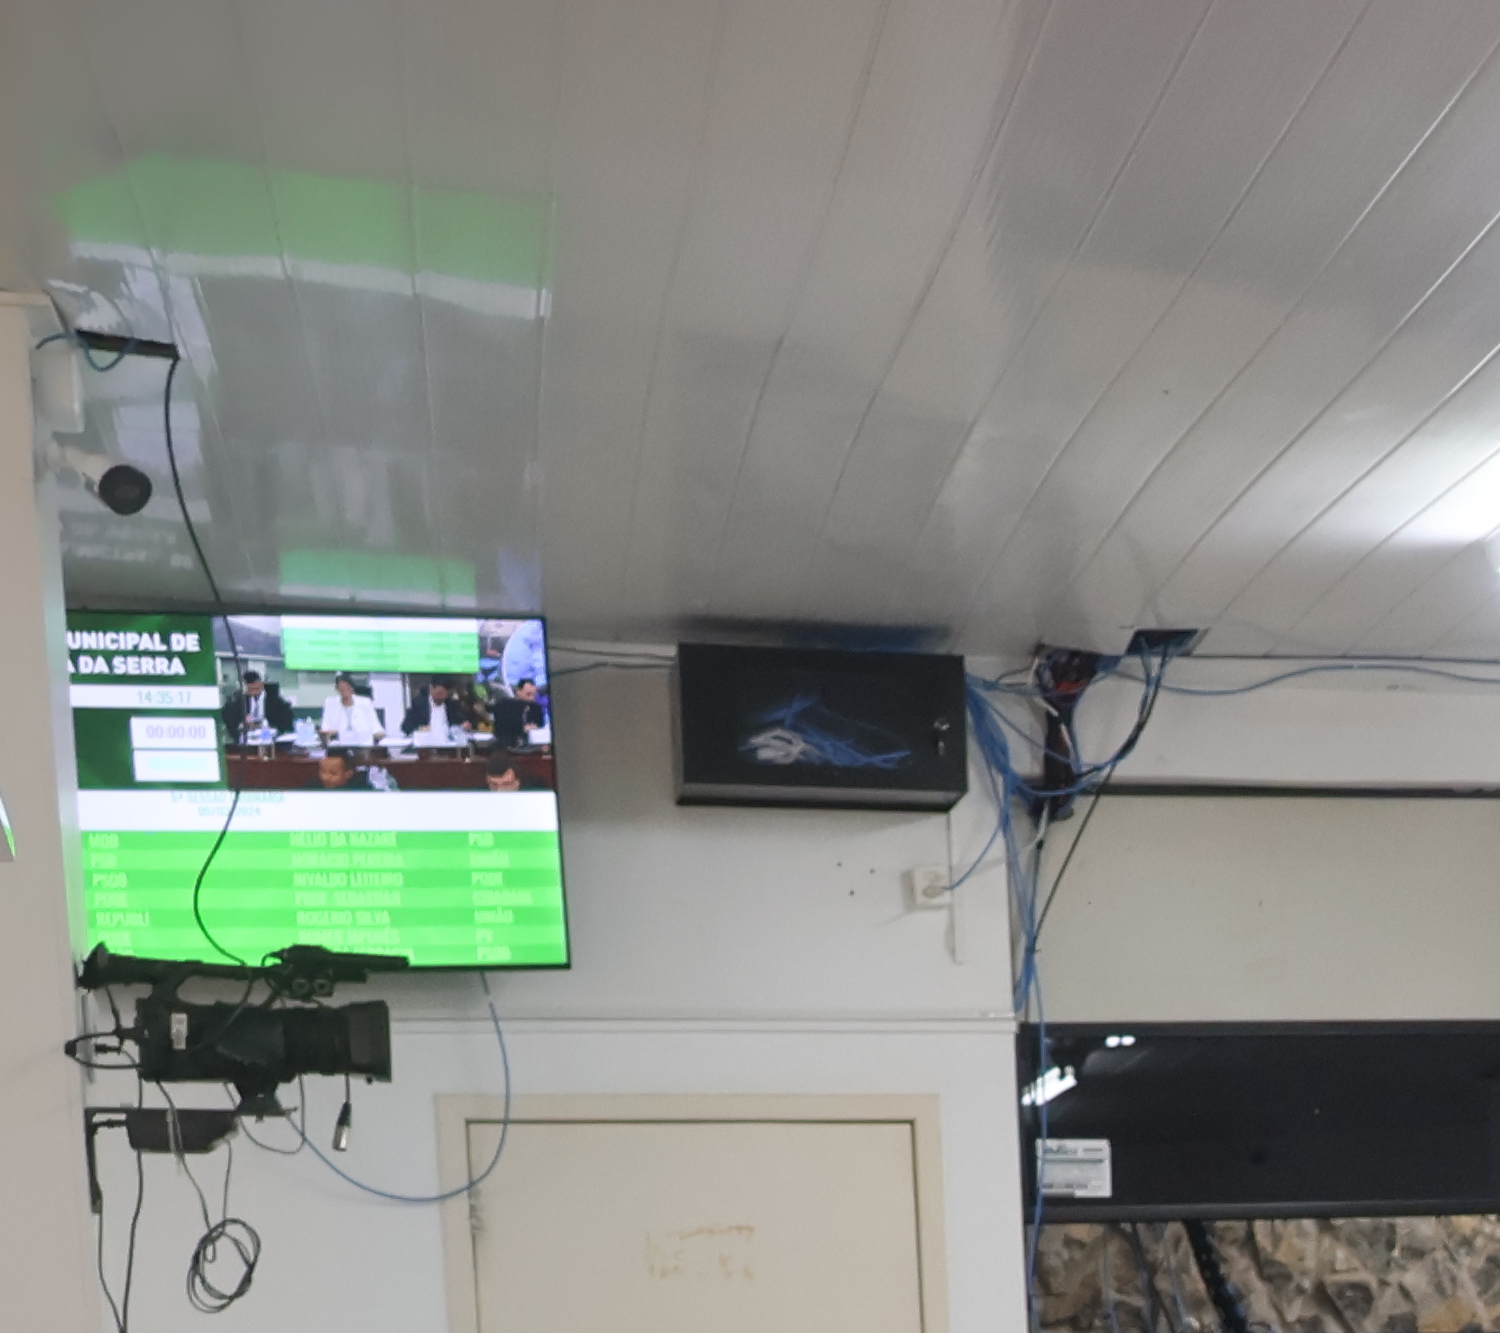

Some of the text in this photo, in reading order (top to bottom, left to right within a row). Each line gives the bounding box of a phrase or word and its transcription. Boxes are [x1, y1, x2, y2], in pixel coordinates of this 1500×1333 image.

[62, 631, 202, 653] UNICIPAL DE
[79, 655, 186, 676] DA SERRA
